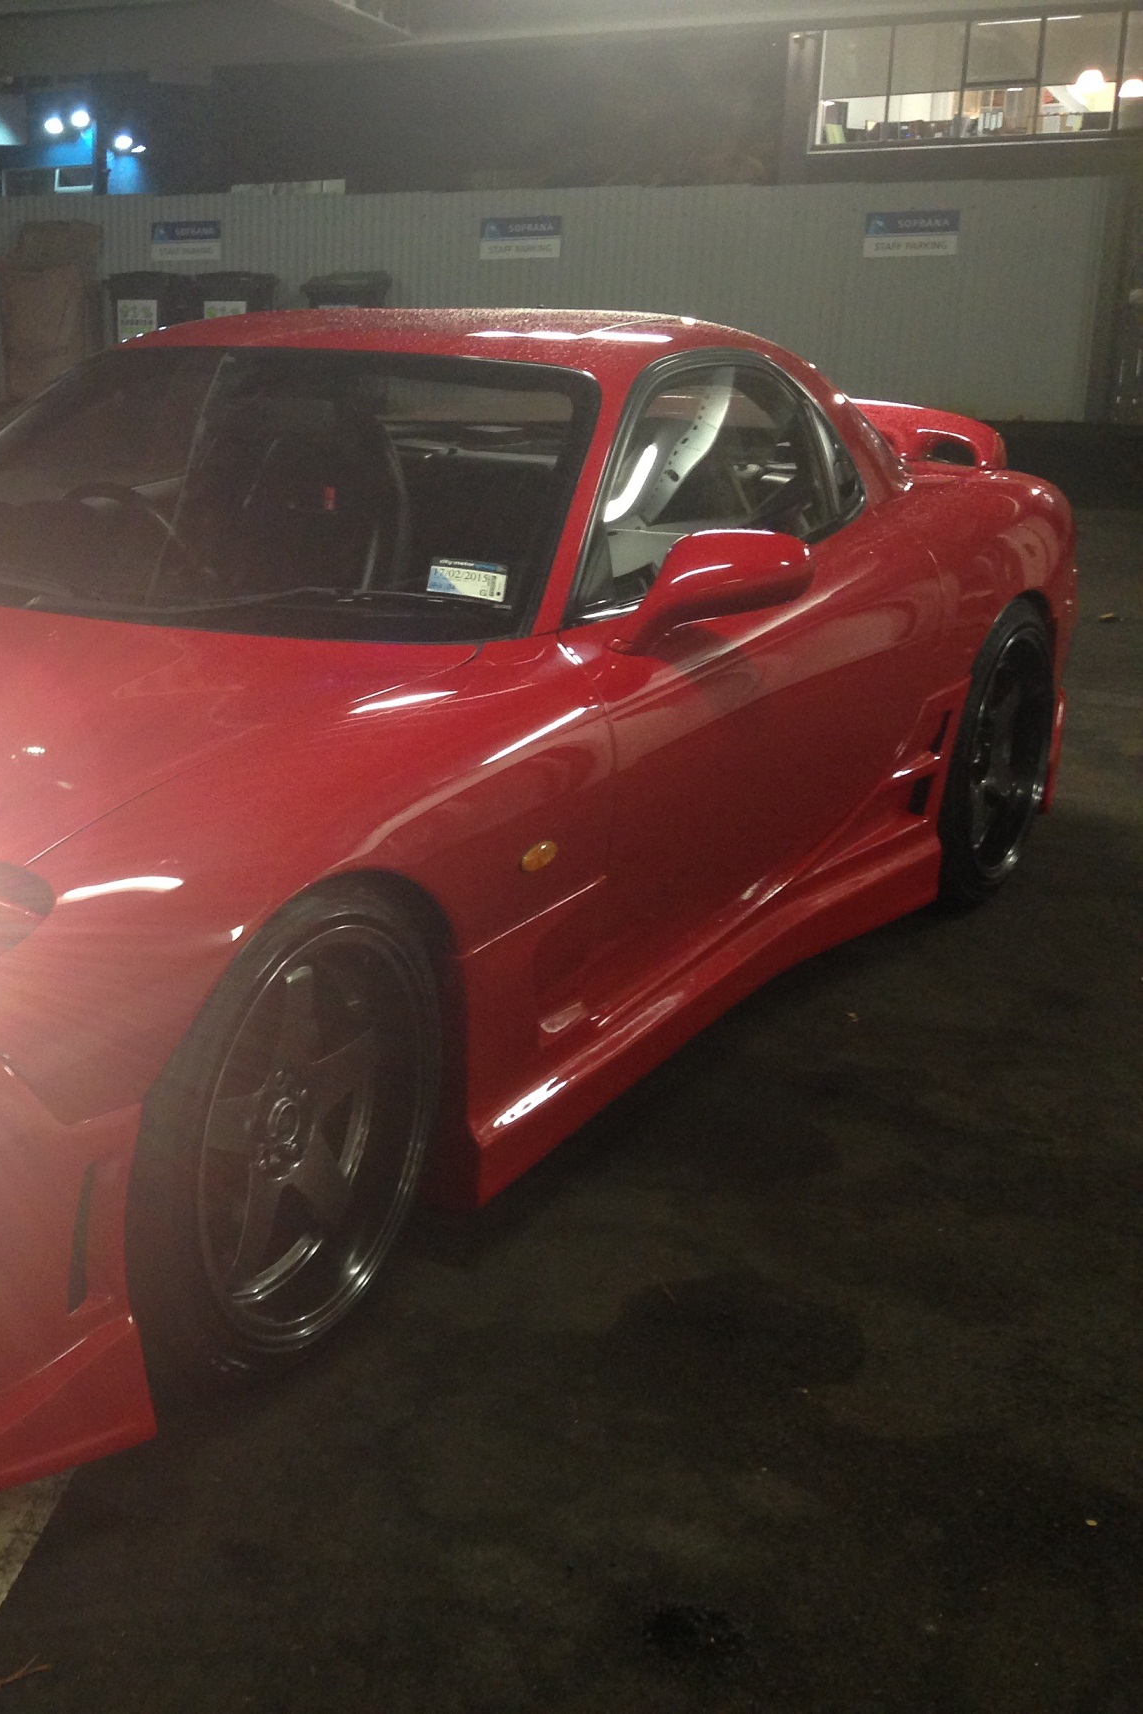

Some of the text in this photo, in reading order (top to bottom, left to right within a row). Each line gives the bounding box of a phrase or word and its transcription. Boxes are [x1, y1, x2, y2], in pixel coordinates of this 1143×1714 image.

[508, 222, 554, 233] SOFRANA
[898, 218, 950, 229] SOFRANA
[488, 244, 553, 254] STAFF PARKING
[874, 240, 948, 251] STAFF PARKING
[433, 568, 488, 583] 17/02/2015
